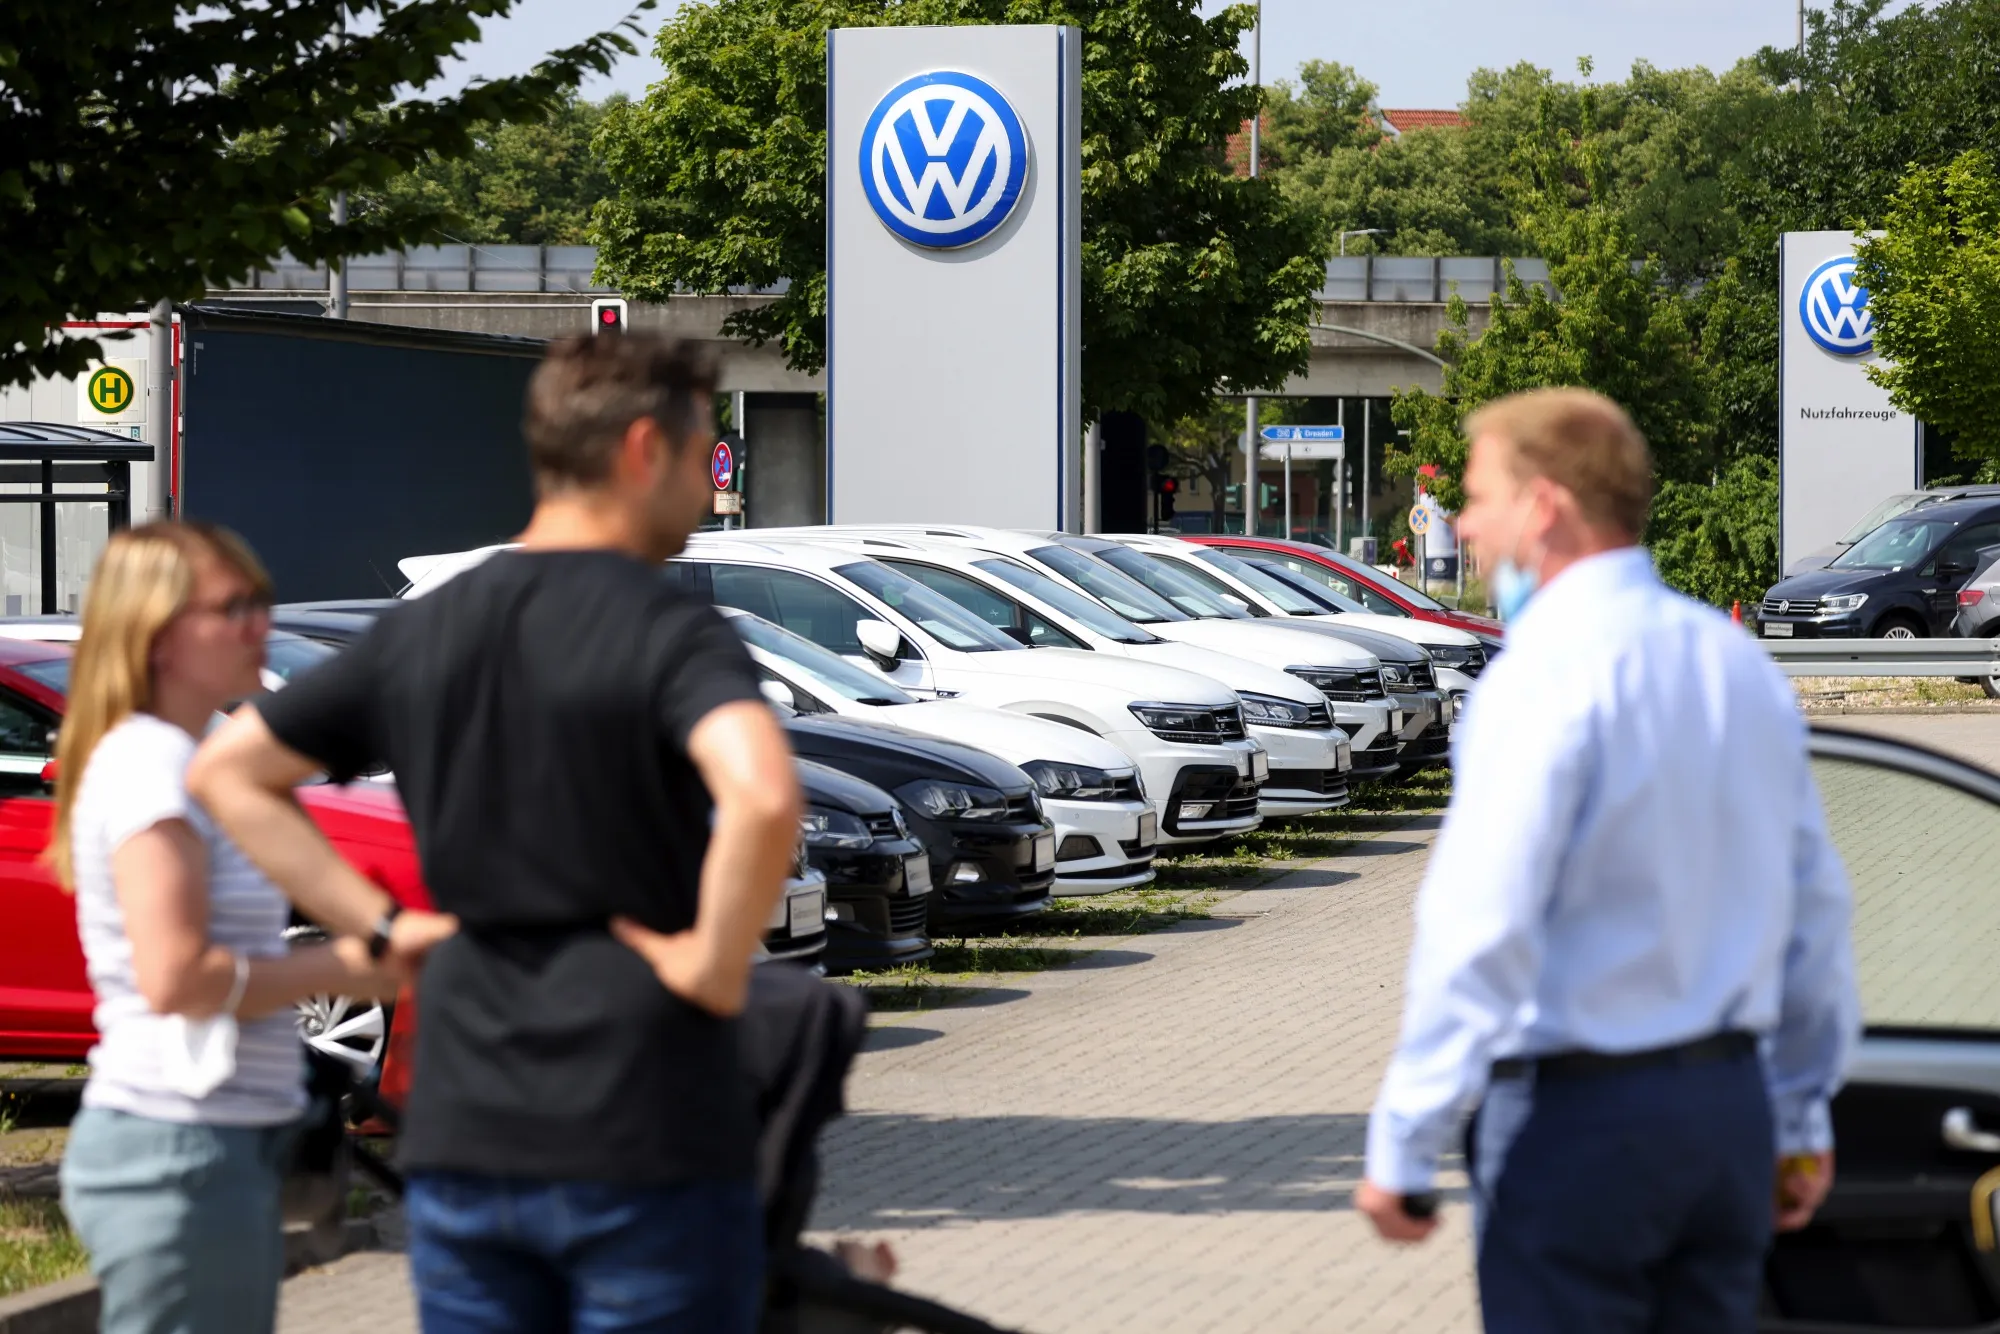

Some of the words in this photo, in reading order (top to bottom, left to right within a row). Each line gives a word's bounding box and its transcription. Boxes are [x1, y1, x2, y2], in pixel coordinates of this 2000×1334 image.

[872, 84, 1011, 233] VW
[100, 378, 121, 403] H
[1801, 406, 1897, 421] Nutzfahrzeuge
